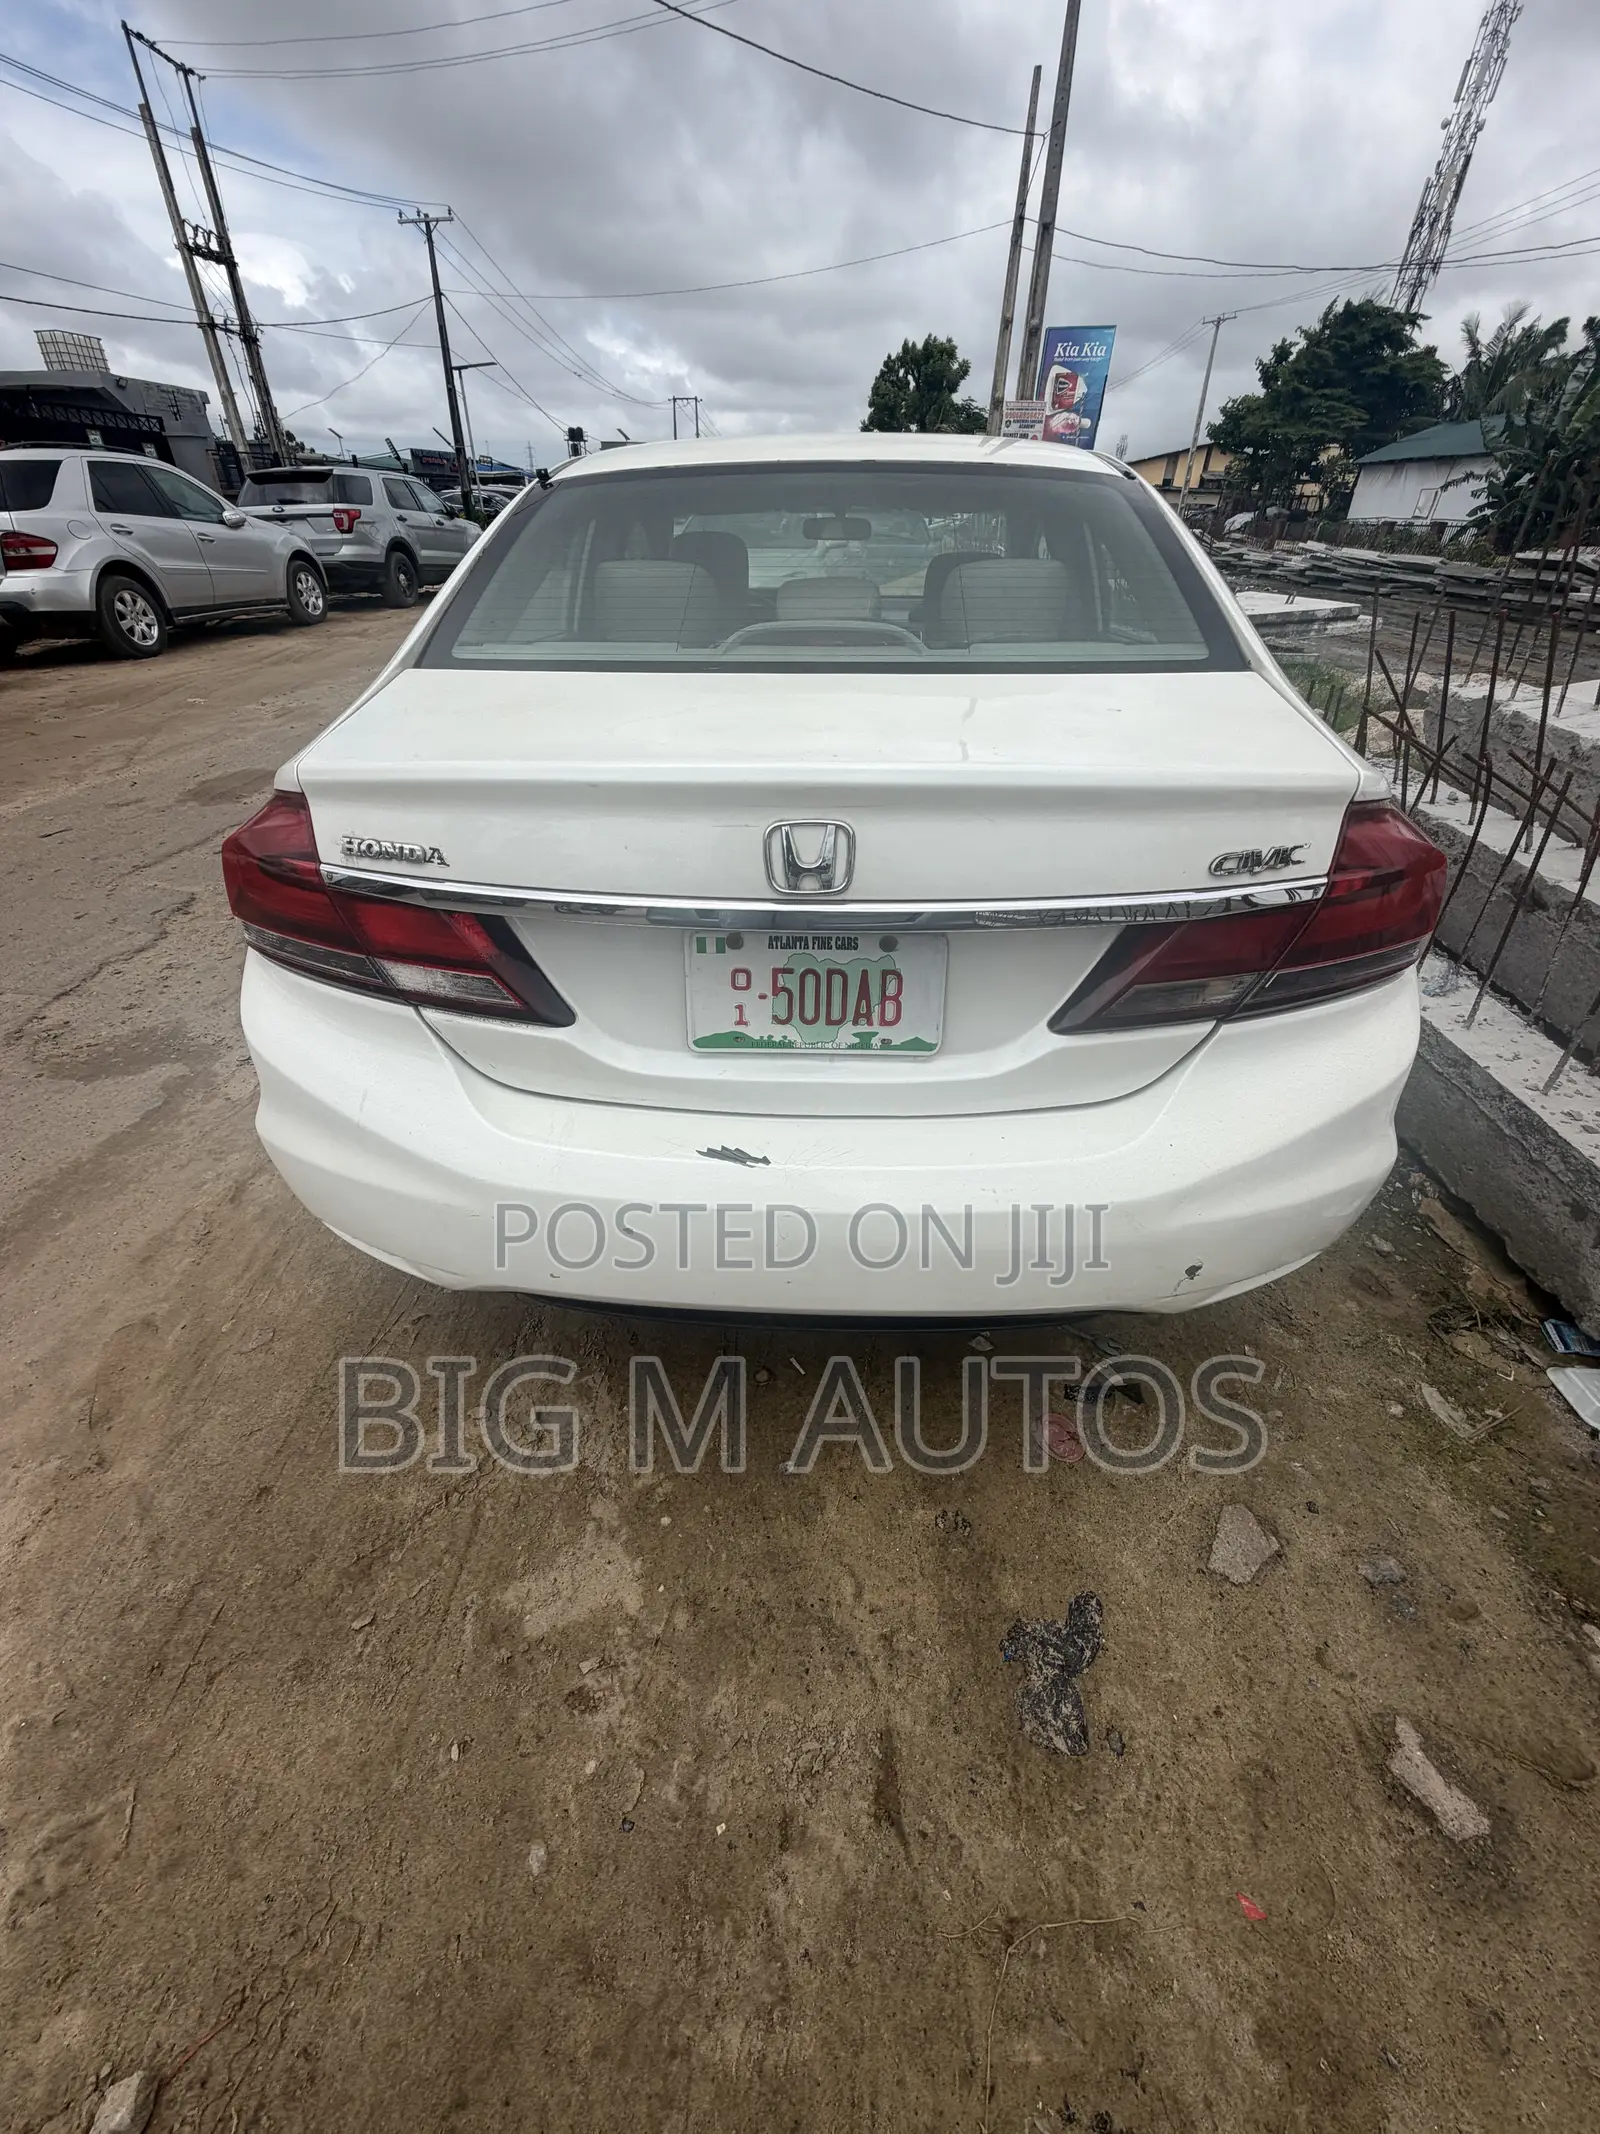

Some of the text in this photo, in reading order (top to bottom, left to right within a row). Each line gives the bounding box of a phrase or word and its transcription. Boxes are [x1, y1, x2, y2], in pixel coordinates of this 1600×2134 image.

[1054, 341, 1107, 357] Kia Kia
[340, 836, 450, 867] HONDA
[1208, 841, 1312, 876] CIVIC
[767, 935, 859, 951] ATLANTA FINE CARS
[751, 1041, 787, 1049] FEDERAL
[789, 1041, 830, 1049] REPUBLIC
[831, 1041, 842, 1049] OF
[843, 1041, 880, 1049] NIGERIA
